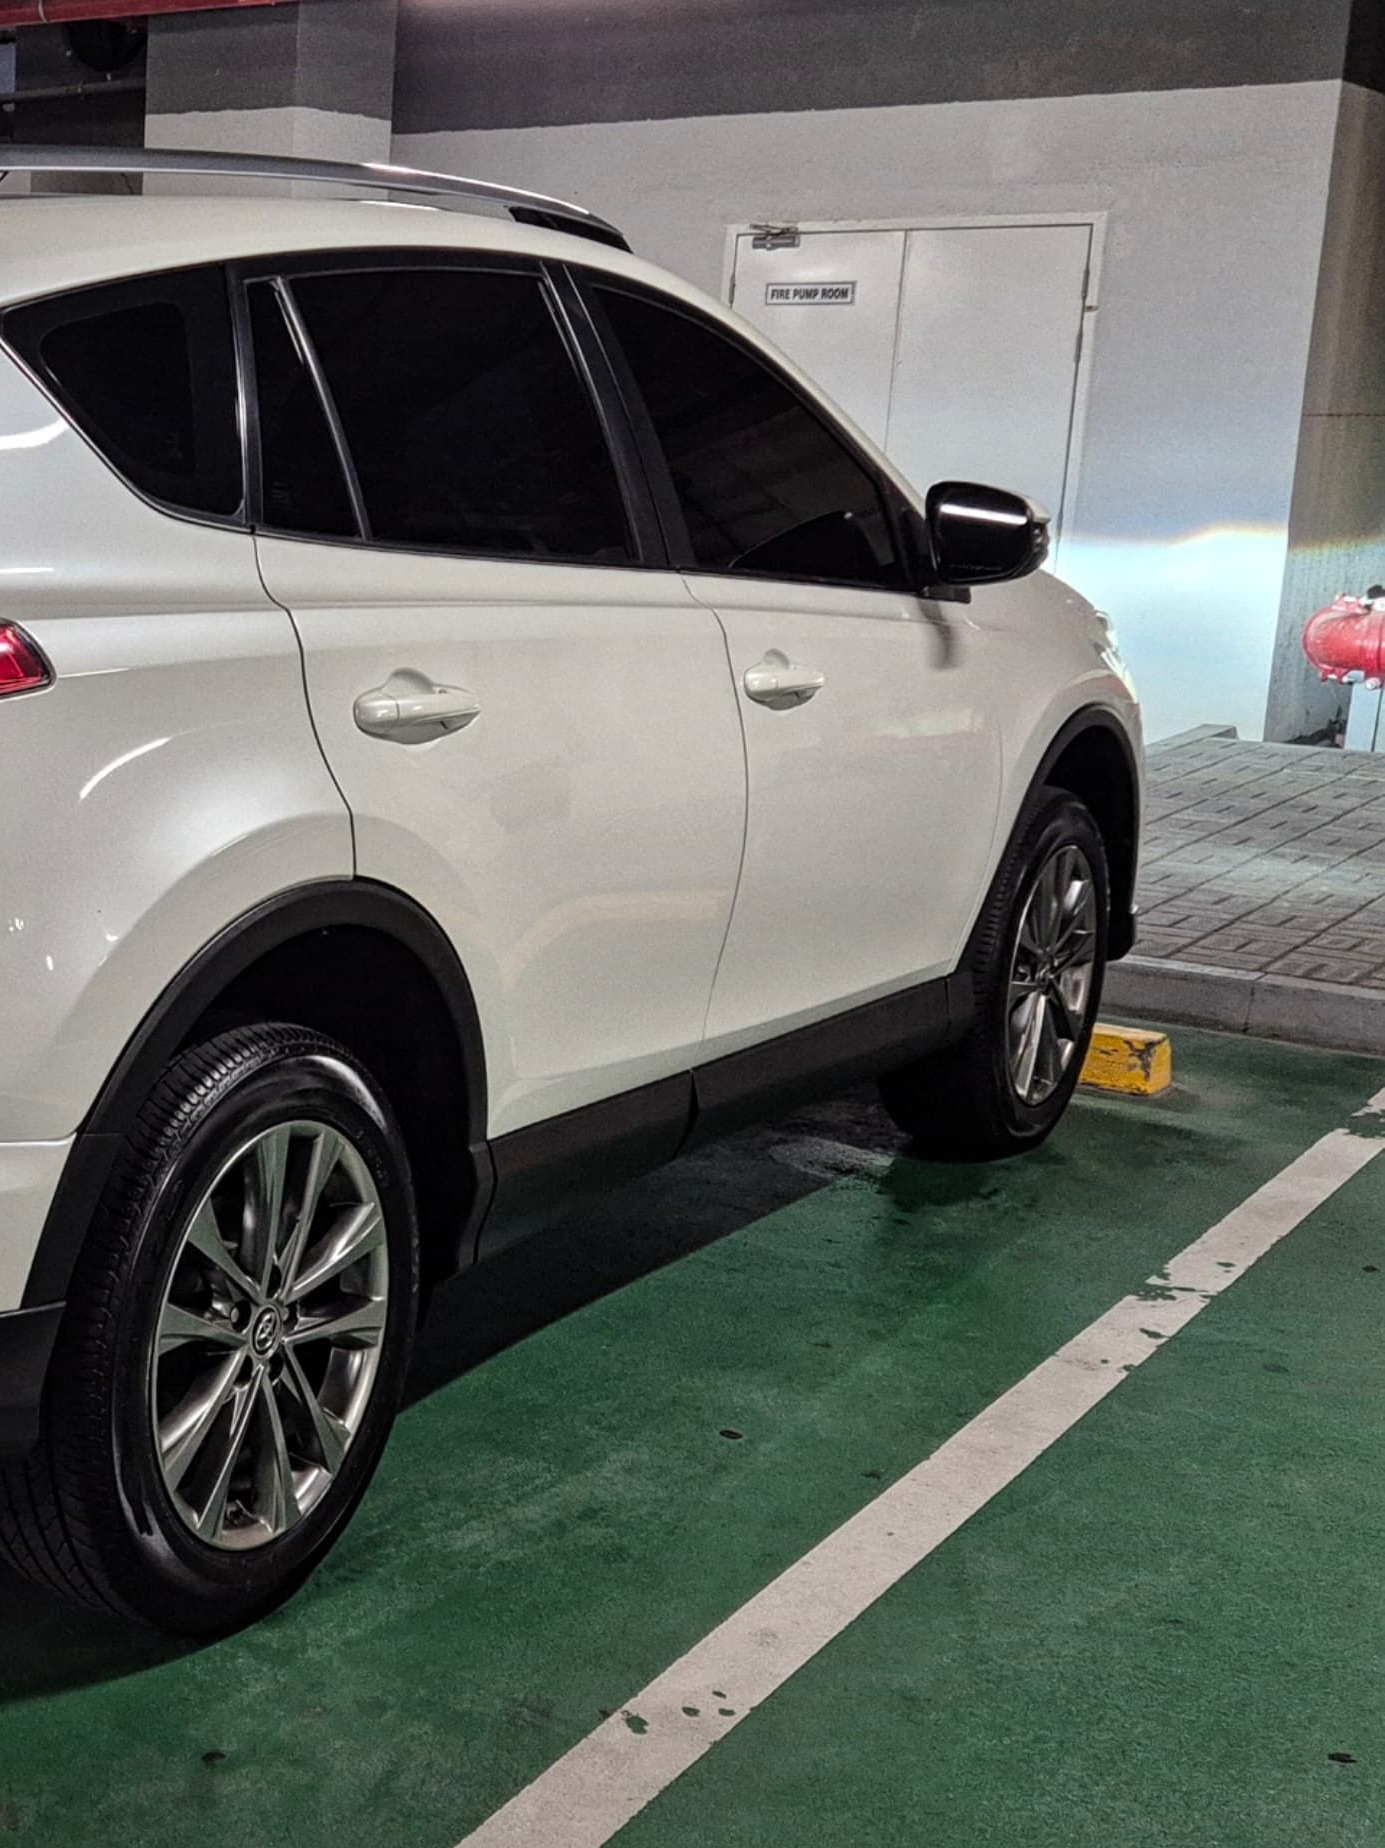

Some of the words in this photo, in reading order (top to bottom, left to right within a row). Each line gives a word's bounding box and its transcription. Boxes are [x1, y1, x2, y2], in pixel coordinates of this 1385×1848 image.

[771, 288, 791, 300] FIRE
[793, 288, 820, 300] PUMP
[821, 287, 849, 299] ROOM
